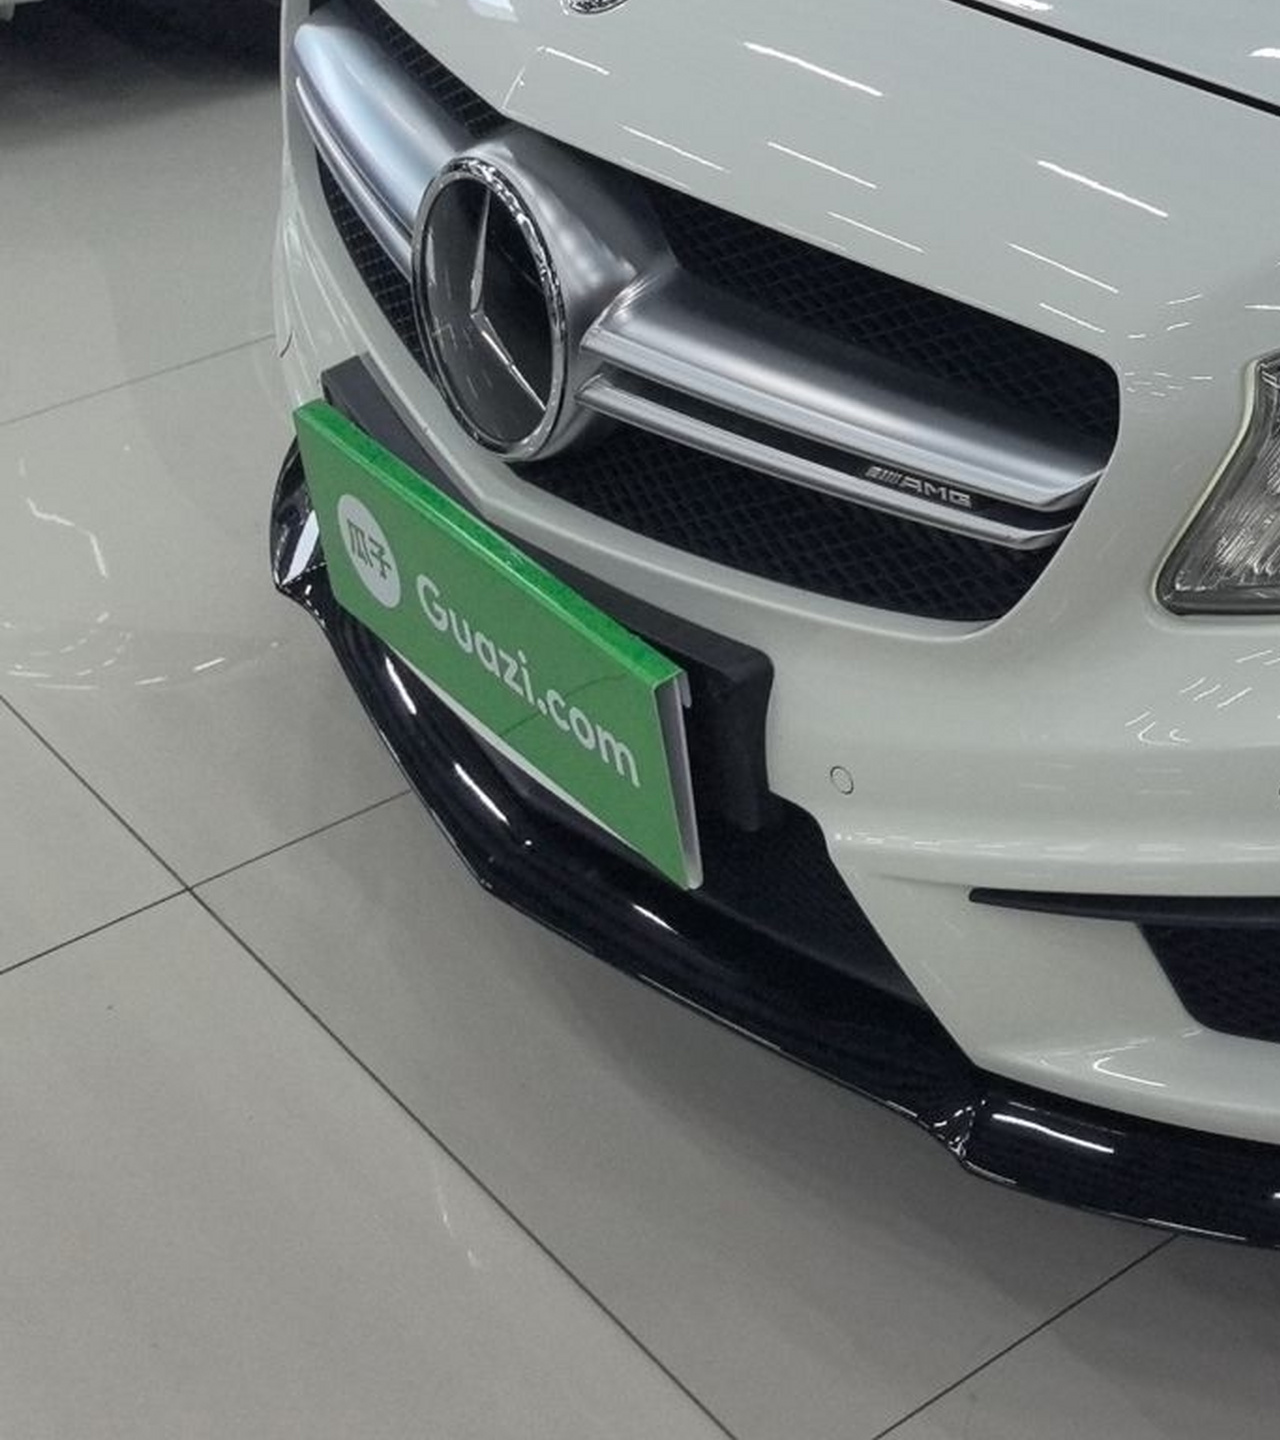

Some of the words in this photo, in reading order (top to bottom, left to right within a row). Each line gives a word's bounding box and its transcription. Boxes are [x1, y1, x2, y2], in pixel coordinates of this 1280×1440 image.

[900, 475, 973, 509] AMG
[346, 517, 393, 581] 瓜子
[416, 573, 641, 788] Guazi.com
